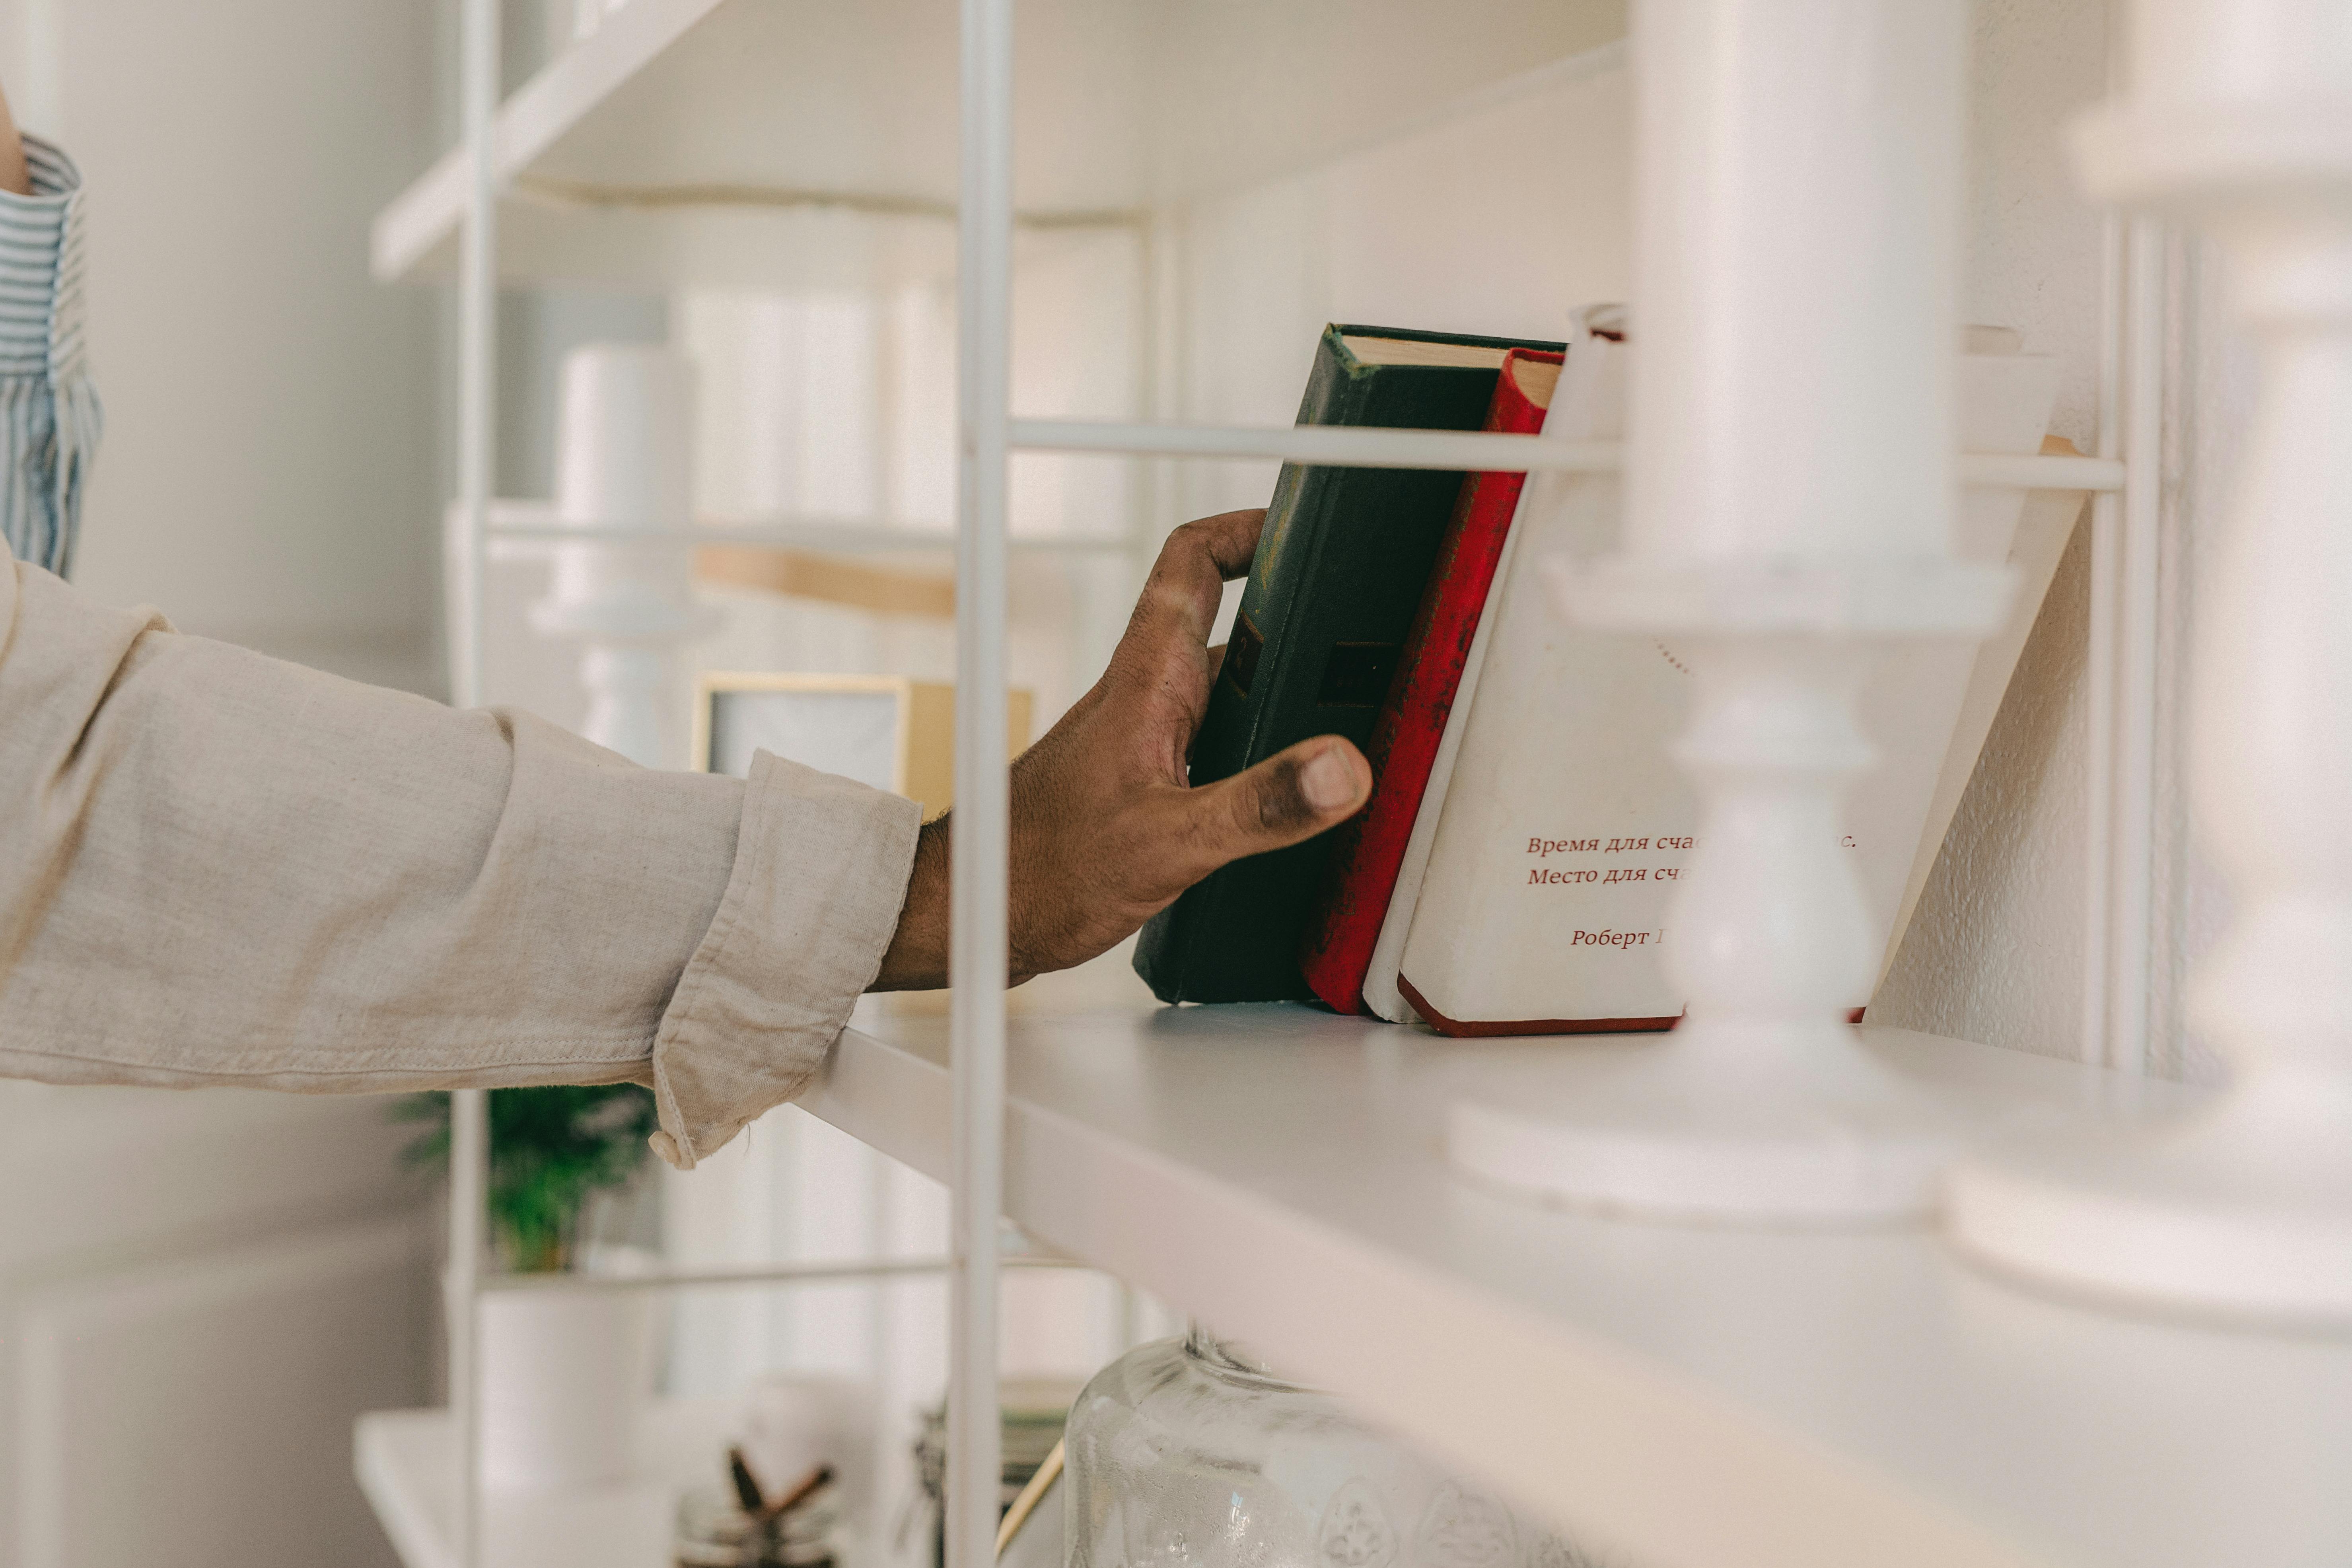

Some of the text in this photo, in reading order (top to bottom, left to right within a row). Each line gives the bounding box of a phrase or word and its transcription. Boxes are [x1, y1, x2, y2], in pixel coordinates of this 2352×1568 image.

[1526, 837, 1600, 857] Время
[1605, 838, 1650, 853] для
[1527, 869, 1598, 884] Место
[1603, 869, 1648, 884] для
[1570, 929, 1650, 949] Роберт
